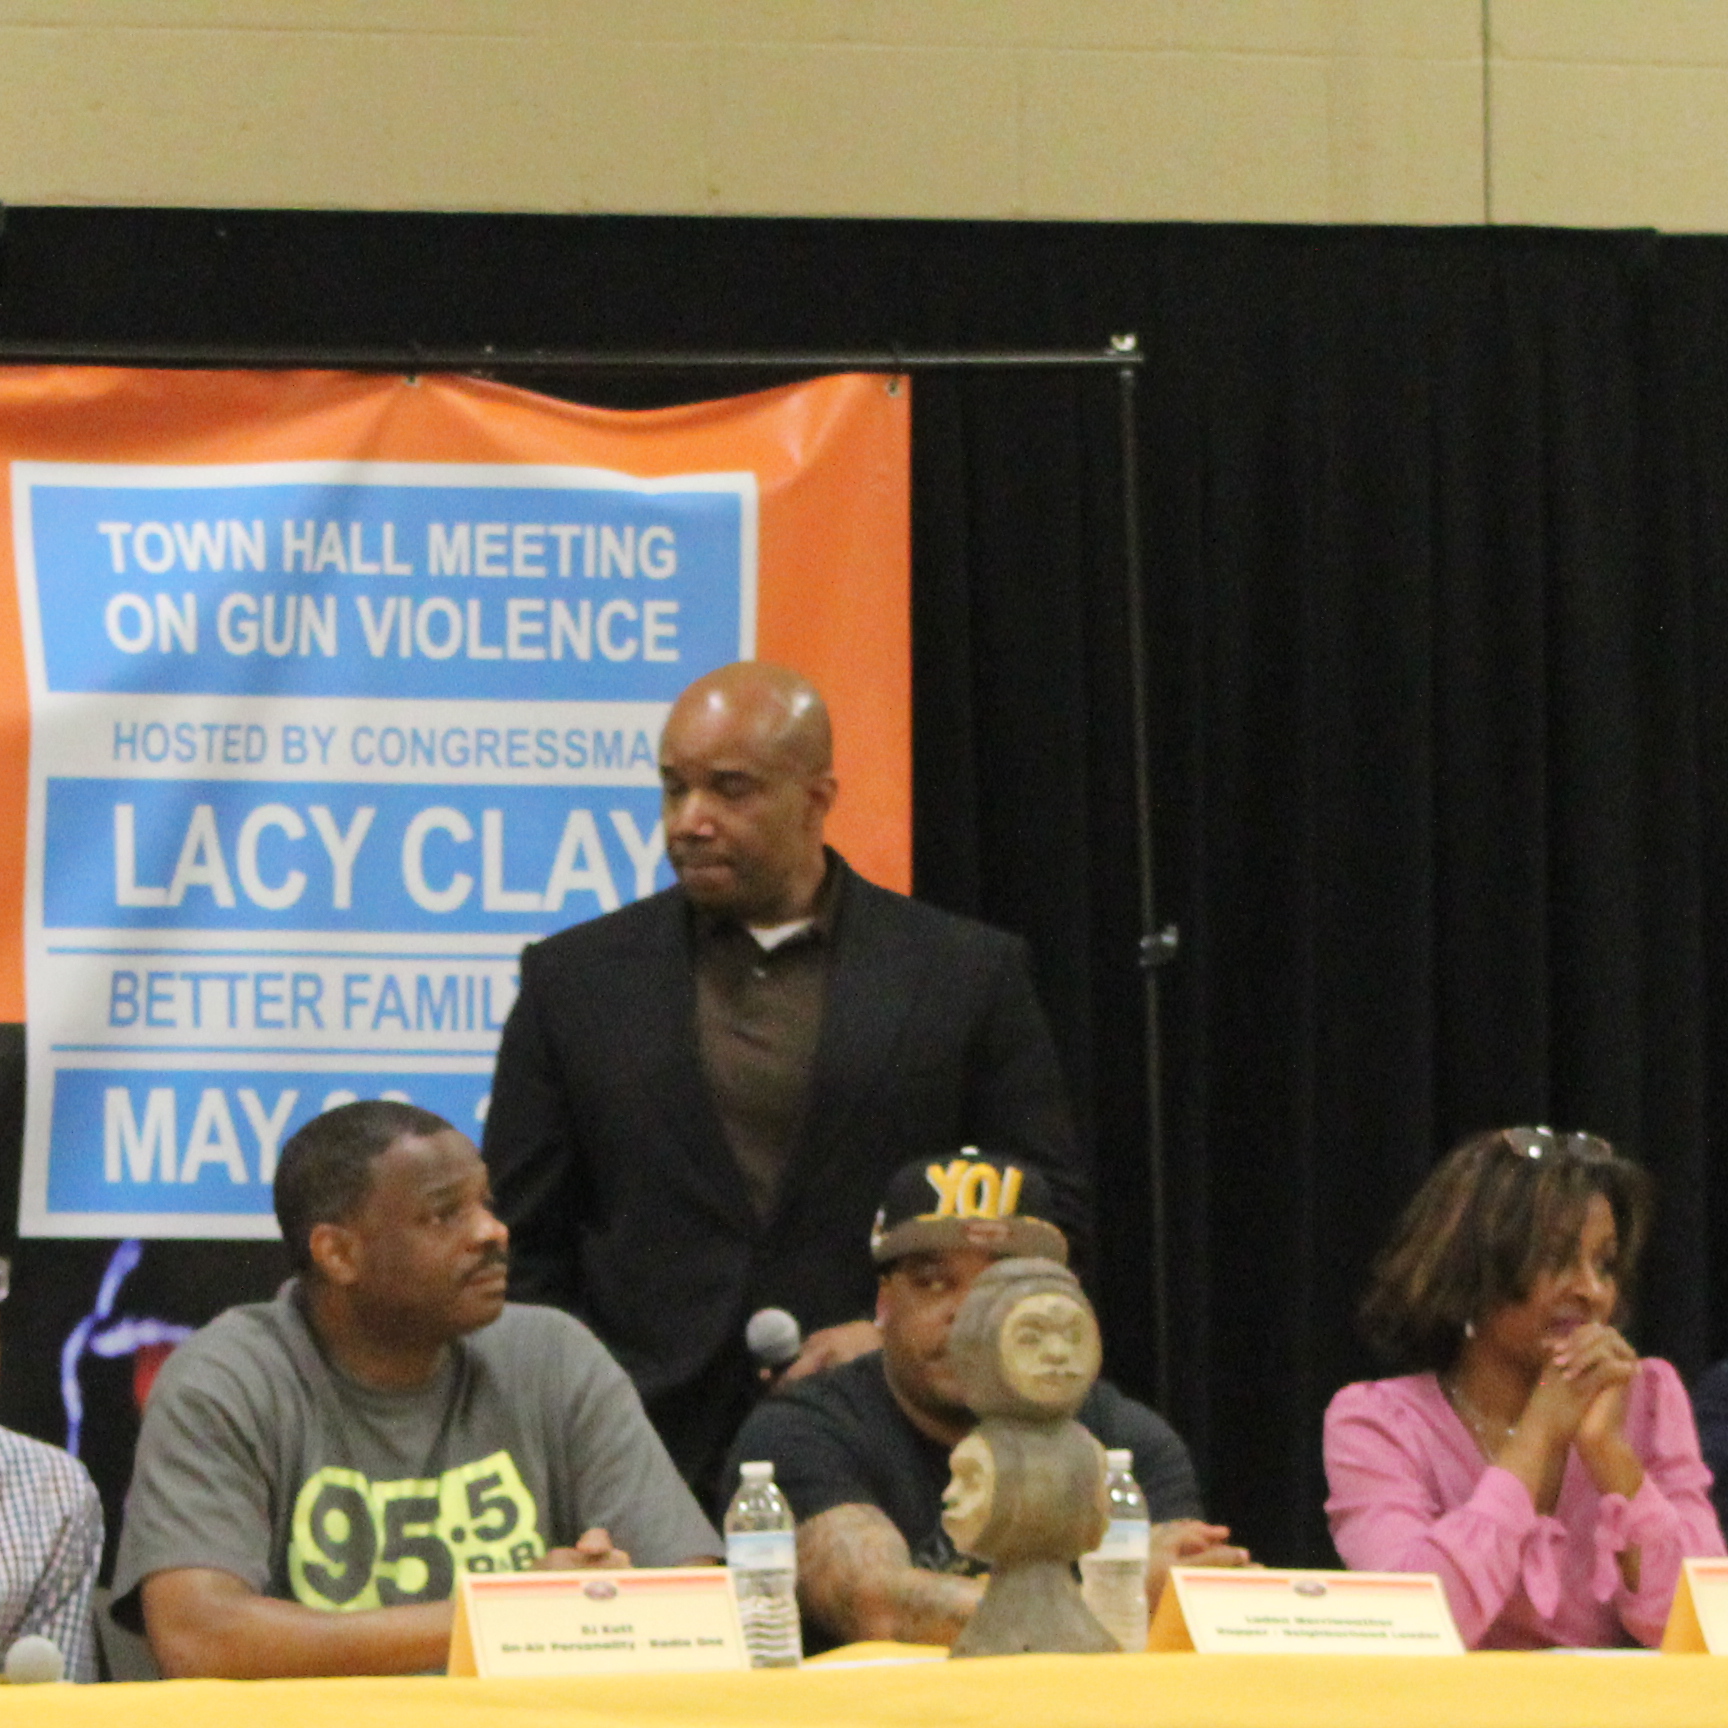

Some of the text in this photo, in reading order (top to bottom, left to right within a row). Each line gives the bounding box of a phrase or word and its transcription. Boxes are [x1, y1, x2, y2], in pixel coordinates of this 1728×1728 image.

[98, 519, 678, 580] TOWN HALL MEETING
[104, 592, 680, 663] ON GUN VIOLENCE
[112, 722, 659, 770] HOSTED BY CONGRESSMA
[114, 803, 671, 914] LACY CLAY
[108, 969, 522, 1032] BETTER FAMIL
[103, 1087, 300, 1184] MAY
[301, 1472, 520, 1606] 95.5
